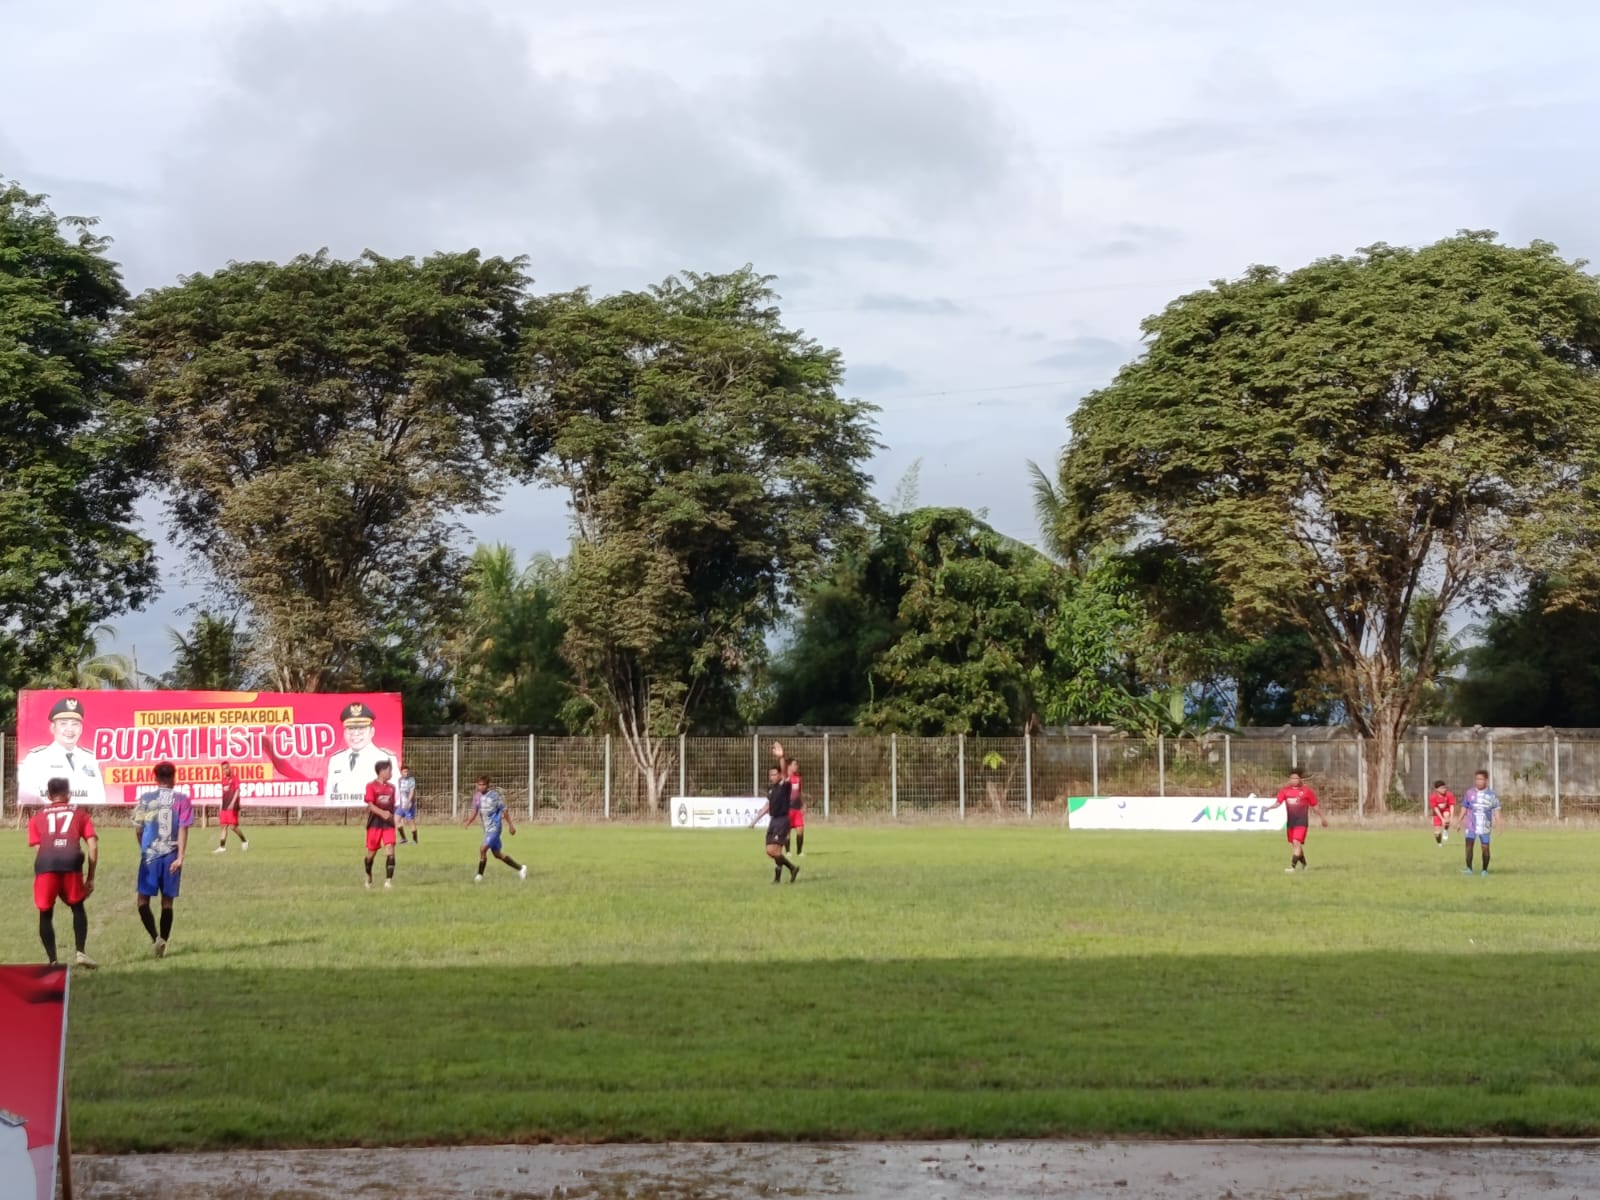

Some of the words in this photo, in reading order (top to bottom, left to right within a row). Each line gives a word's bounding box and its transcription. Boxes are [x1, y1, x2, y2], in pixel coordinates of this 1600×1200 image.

[140, 711, 215, 726] TOURNAMEN
[220, 709, 290, 724] SEPAKBOLA
[95, 727, 199, 762] BUPATI
[208, 724, 266, 759] HST
[273, 723, 336, 758] CUP
[112, 767, 157, 783] SELAM
[178, 764, 265, 781] BERTADING
[193, 783, 223, 798] TING
[47, 811, 74, 834] 17
